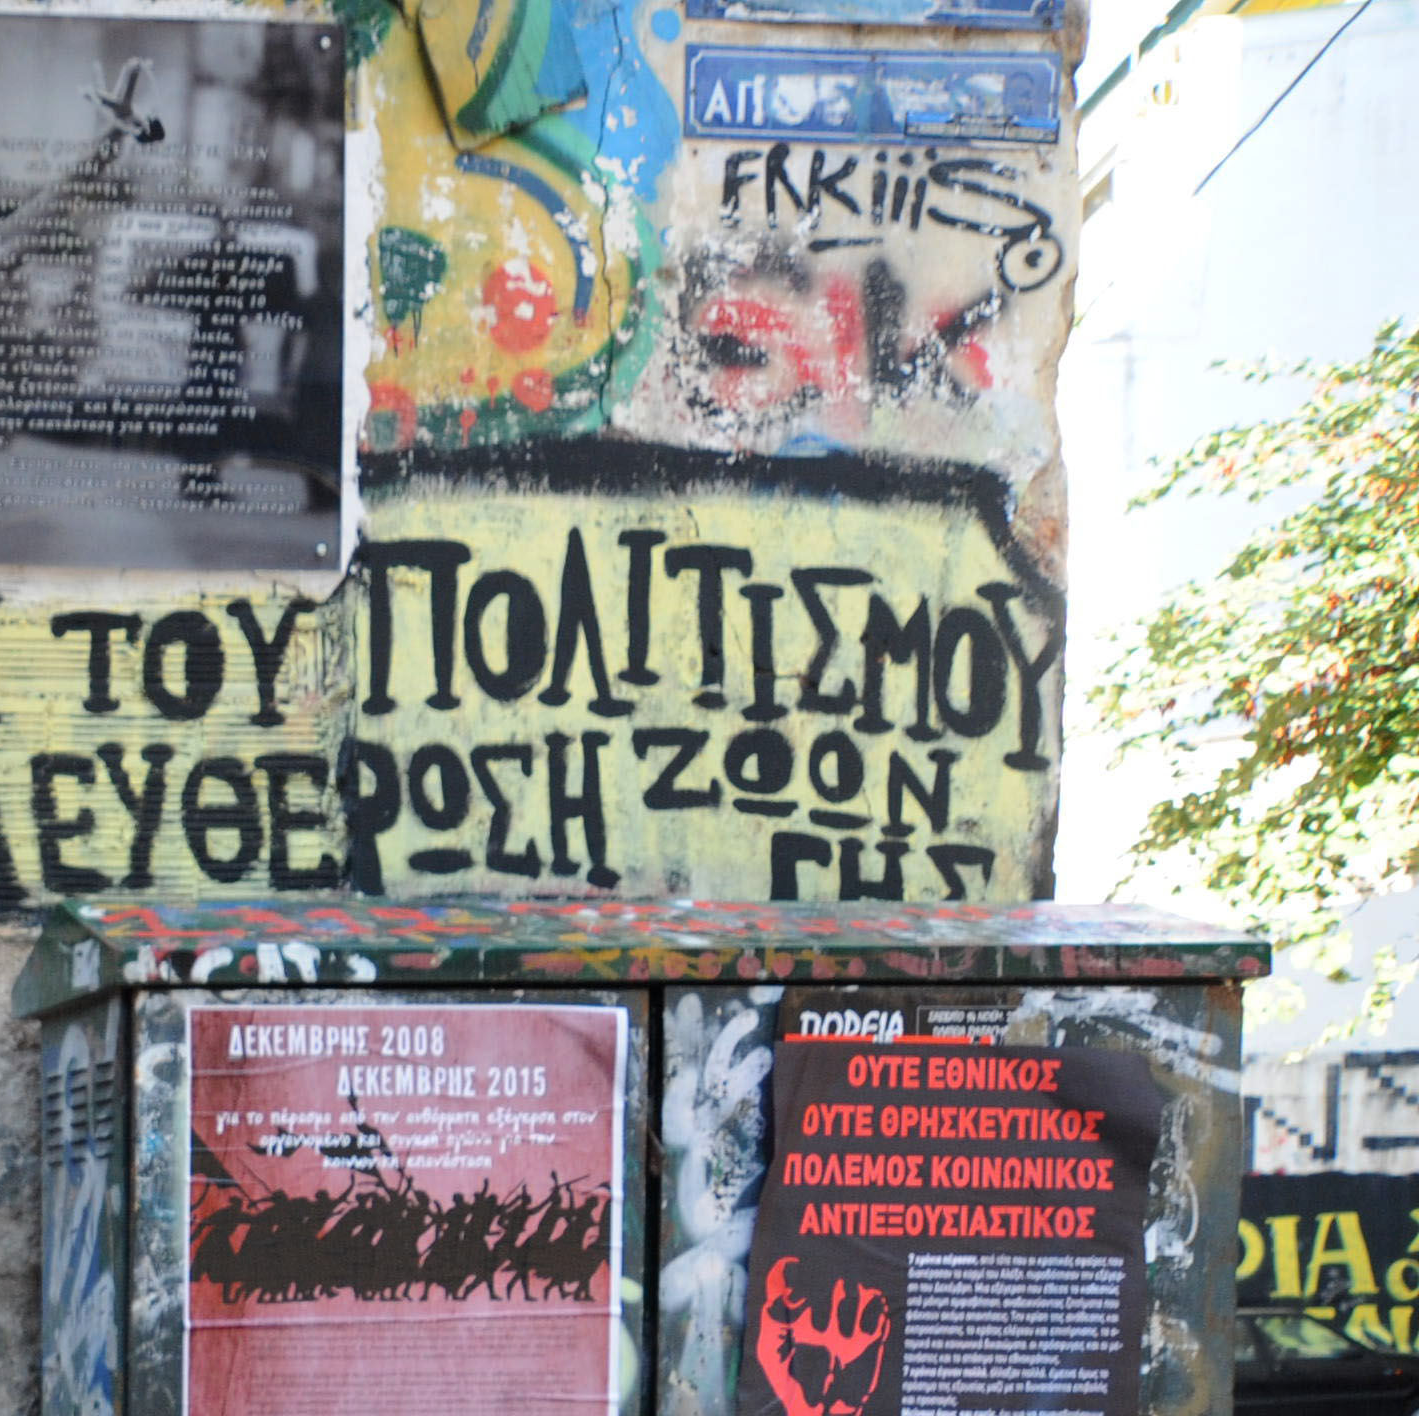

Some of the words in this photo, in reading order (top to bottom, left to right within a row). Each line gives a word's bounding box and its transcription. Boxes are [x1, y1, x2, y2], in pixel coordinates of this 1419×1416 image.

[51, 598, 317, 728] ΤΟΥ
[357, 527, 1066, 772] ΠΟΛΙΤΙΣΜΟΥ
[228, 1024, 371, 1059] ΔΕΚΕΜΒΡΗΣ
[381, 1024, 445, 1057] 2008
[336, 1065, 477, 1097] ΔΕΚΕΜΒΡΗΣ
[487, 1066, 547, 1097] 2015
[848, 1055, 921, 1089] ΟΥΤΕ
[927, 1056, 1062, 1092] ΕΘΝΙΚΟΣ
[801, 1102, 874, 1137] ΟΥΤΕ
[880, 1104, 1105, 1142] ΘΡΗΣΚΕΥΤΙΚΟΣ
[783, 1152, 925, 1188] ΠΟΛΕΜΟΣ
[930, 1154, 1115, 1191] ΚΟΙΝΩΝΙΚΟΣ
[799, 1202, 1097, 1239] ΑΝΤΙΕΞΟΥΣΙΑΣΤΙΚΟΣ
